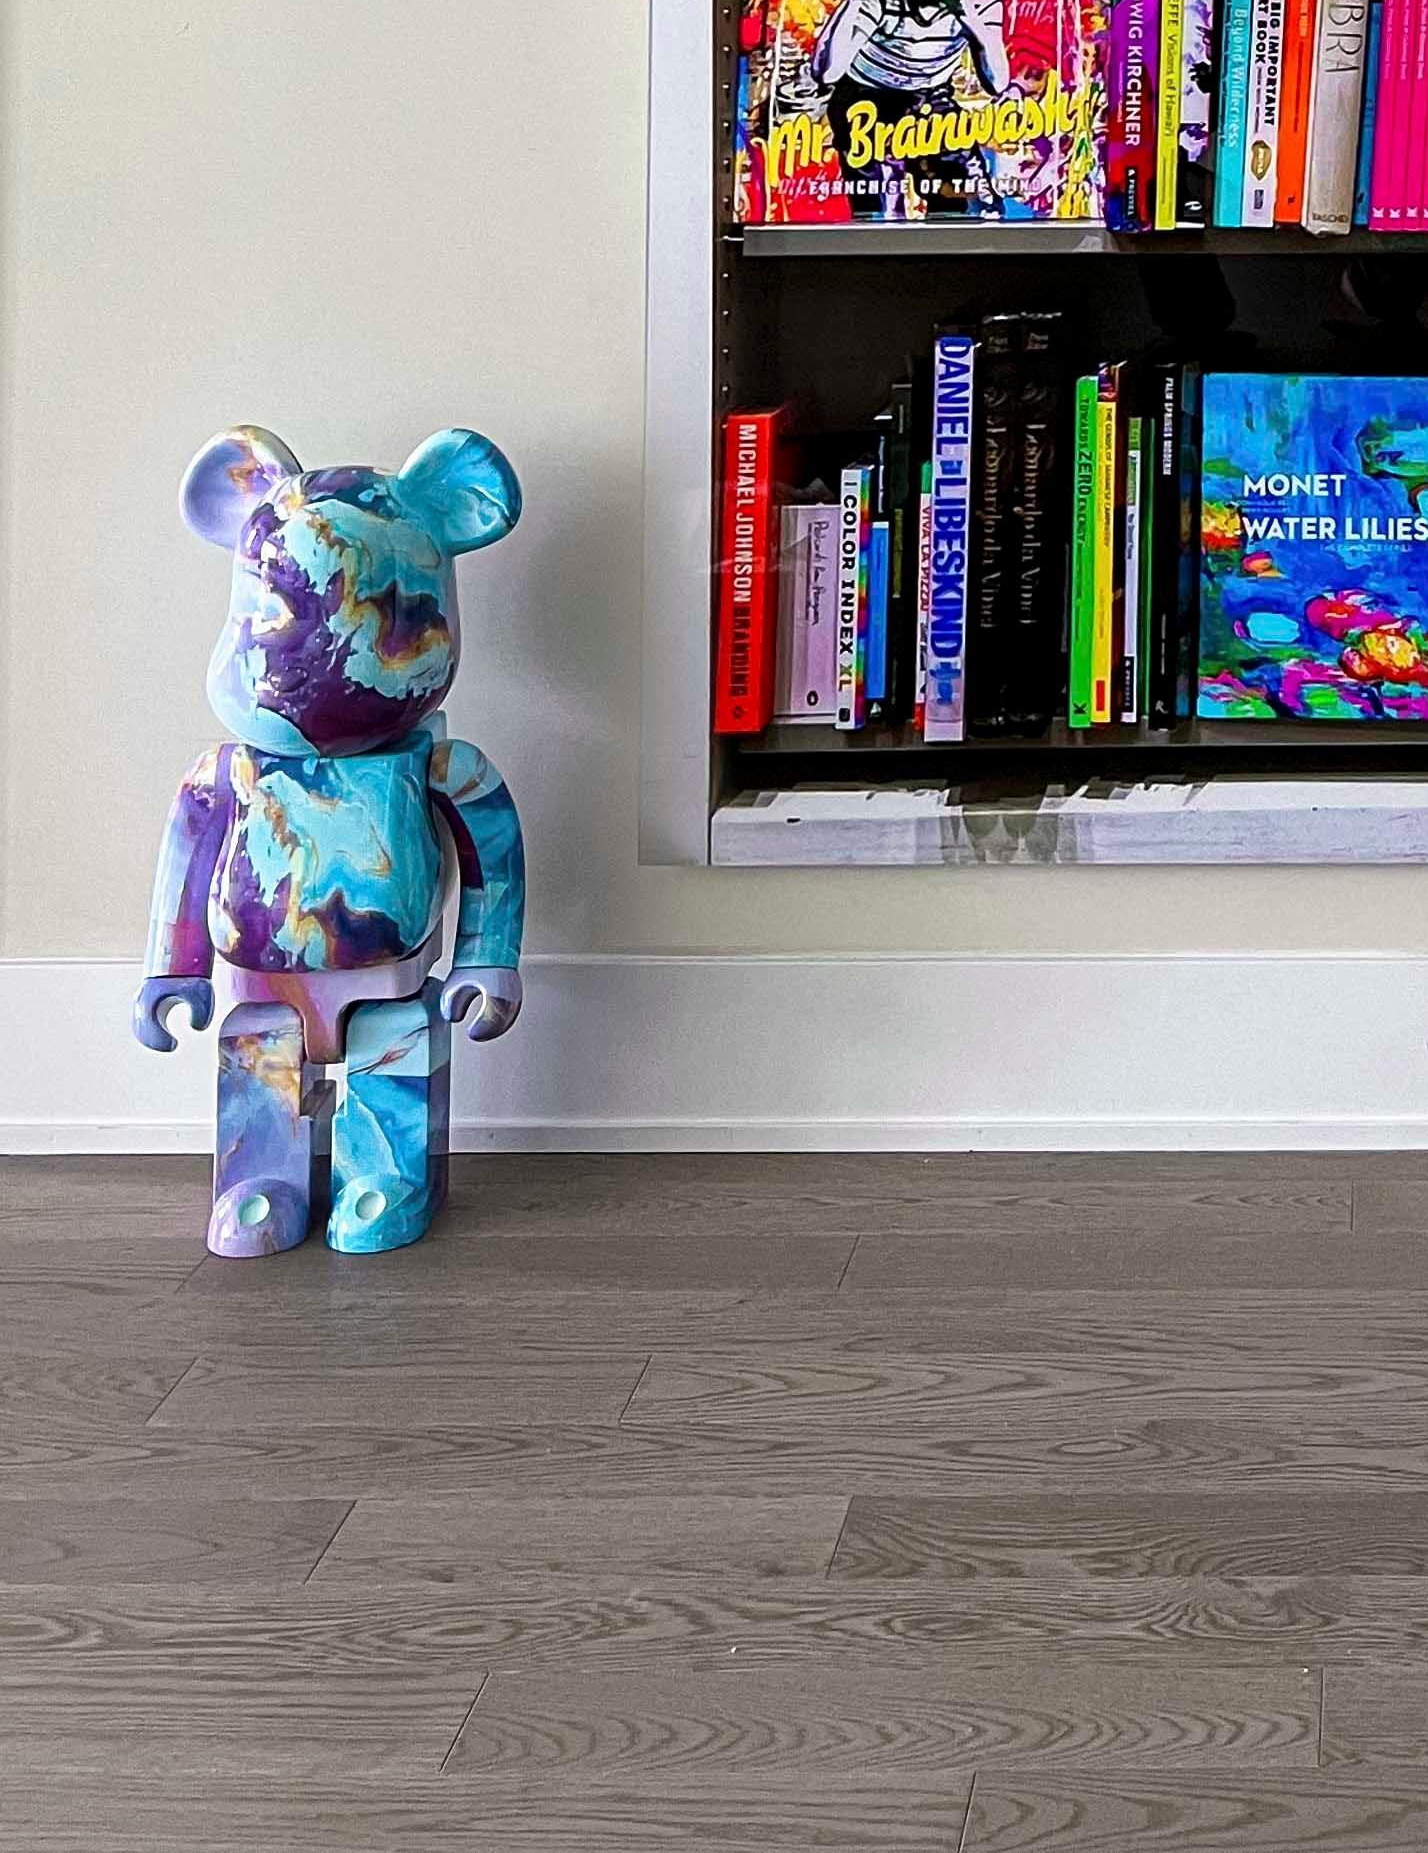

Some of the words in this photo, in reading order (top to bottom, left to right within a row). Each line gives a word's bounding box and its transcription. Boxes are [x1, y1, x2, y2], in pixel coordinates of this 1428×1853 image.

[1229, 8, 1250, 63] Beyond
[1255, 19, 1268, 64] BOOK
[1268, 1, 1282, 29] BIG
[1226, 66, 1248, 148] Wilderness
[1264, 34, 1280, 126] IMPORTANT
[766, 113, 839, 189] Mr.
[846, 83, 1086, 169] Brainwash
[936, 337, 970, 456] DANIEL
[736, 423, 757, 508] MICHAEL
[1242, 473, 1347, 497] MONET
[733, 512, 754, 602] JOHNSON
[841, 494, 858, 570] COLOR
[1242, 516, 1336, 540] WATER
[928, 477, 967, 659] LIBESKIND
[839, 579, 855, 655] INDEX
[838, 663, 854, 692] XL
